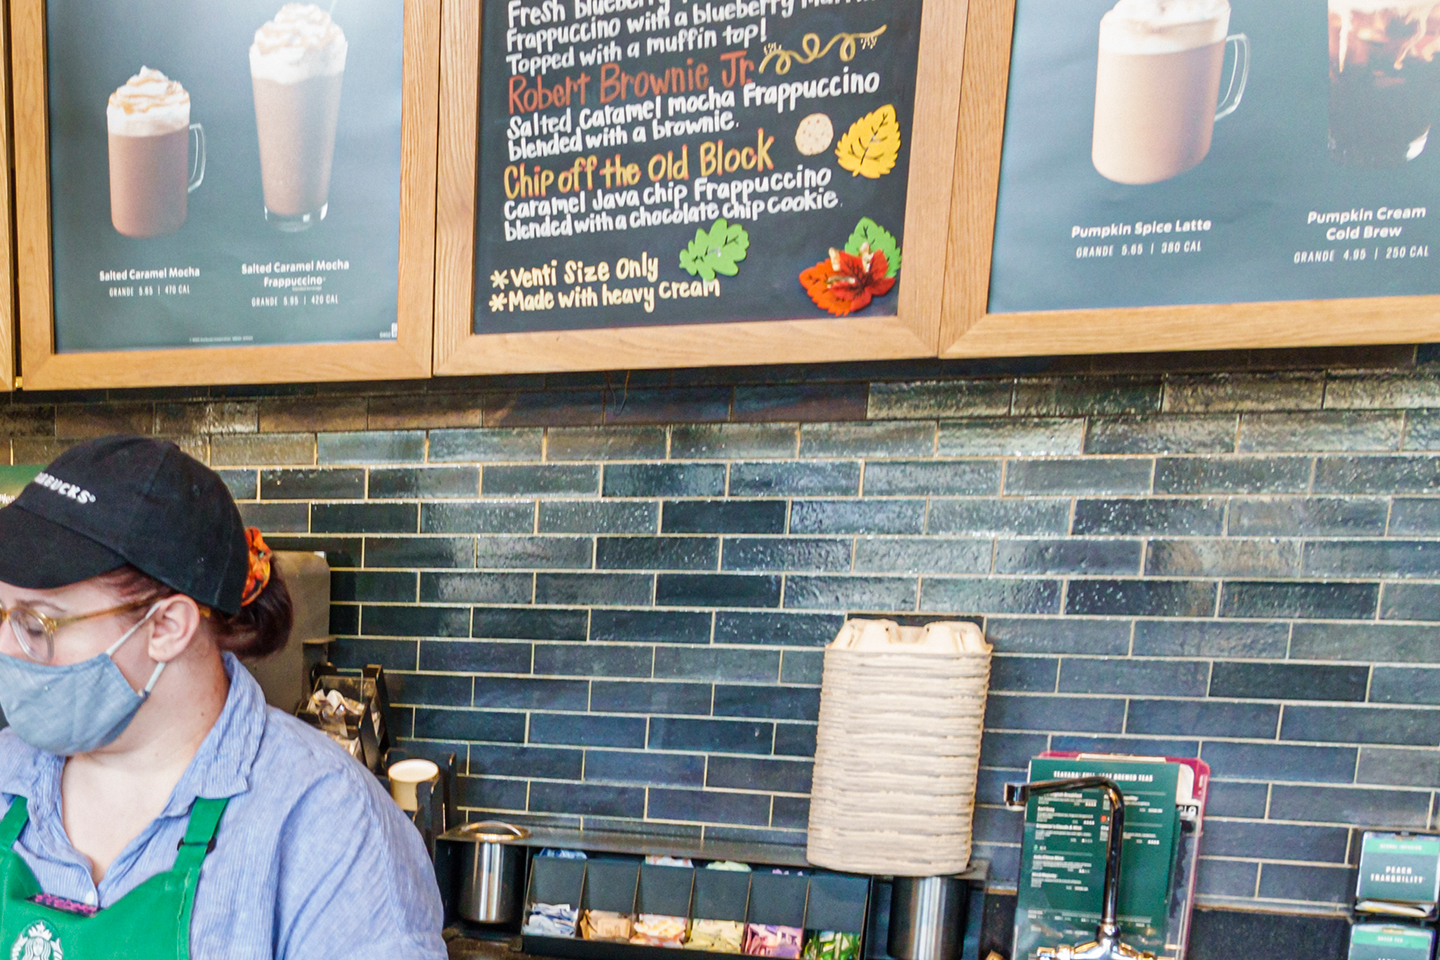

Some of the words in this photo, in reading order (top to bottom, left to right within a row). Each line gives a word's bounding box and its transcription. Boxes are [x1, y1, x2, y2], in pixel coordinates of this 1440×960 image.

[506, 17, 621, 54] Frappuccino
[626, 10, 670, 34] with
[675, 11, 688, 27] a
[692, 0, 794, 25] blueberry
[506, 46, 575, 77] Topped
[579, 41, 622, 67] with
[627, 42, 640, 59] a
[646, 27, 717, 56] muffin
[722, 18, 767, 48] top!
[509, 72, 591, 114] Robert
[600, 58, 709, 104] Brownie
[720, 50, 755, 86] Jr.
[507, 107, 572, 140] Salted
[668, 86, 735, 116] mocha
[743, 66, 880, 114] Frappuccino
[508, 126, 583, 162] blended
[585, 125, 628, 148] with
[632, 126, 646, 143] a
[504, 162, 554, 199] Chip
[558, 155, 598, 193] off
[599, 154, 642, 190] the
[648, 144, 689, 182] Old
[700, 128, 775, 177] Block
[592, 189, 640, 211] Java
[694, 164, 832, 205] Frappuccino
[504, 214, 572, 242] blended
[574, 211, 613, 234] with
[615, 215, 627, 230] a
[1071, 223, 1131, 239] Pumpkin
[1134, 221, 1172, 237] Spice
[1175, 219, 1211, 233] Latte
[1307, 208, 1373, 225] Pumpkin
[1377, 206, 1427, 220] Cream
[1326, 226, 1360, 241] Cold
[1363, 225, 1403, 240] Brew
[241, 262, 272, 275] Salted
[274, 260, 314, 273] Caramel
[316, 258, 350, 271] Mocha
[510, 259, 558, 288] Venti
[564, 260, 610, 284] Size
[616, 251, 659, 283] Only
[509, 288, 555, 312] Made
[558, 285, 598, 308] with
[601, 284, 655, 313] heavy
[658, 278, 720, 299] cream
